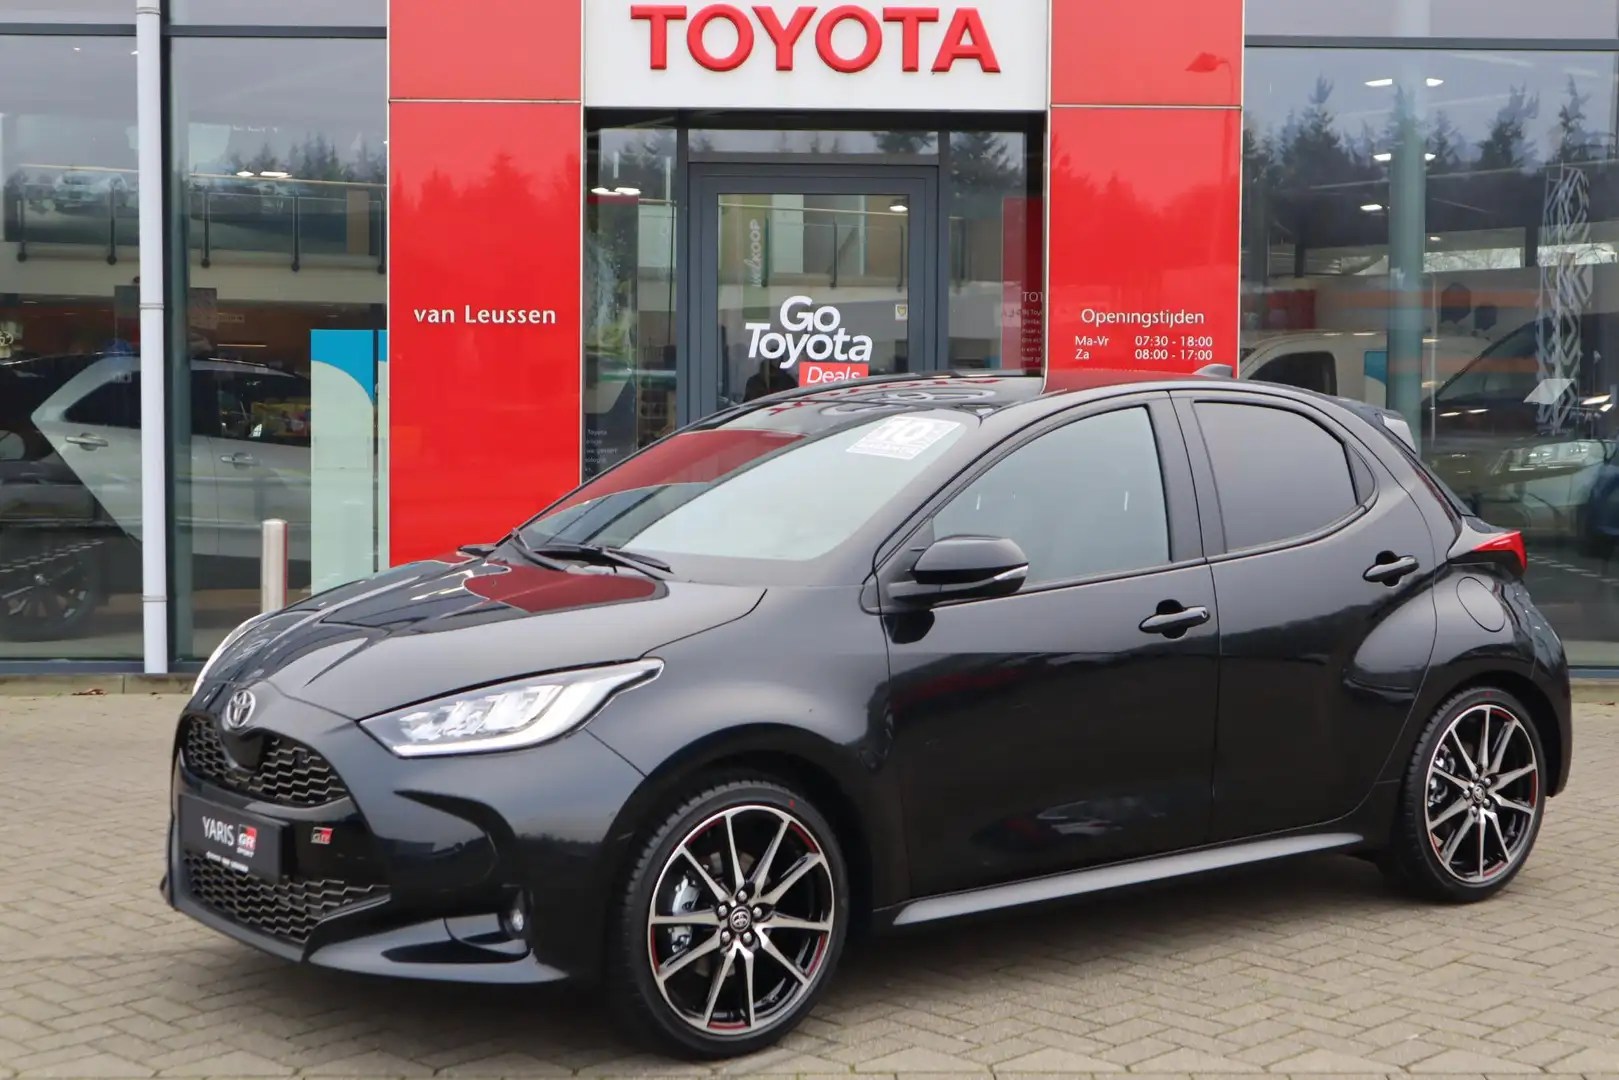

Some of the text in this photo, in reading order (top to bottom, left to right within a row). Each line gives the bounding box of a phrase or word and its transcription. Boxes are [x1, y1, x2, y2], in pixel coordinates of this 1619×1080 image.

[630, 3, 1001, 74] TOYOTA
[413, 304, 557, 324] van Leussen
[779, 295, 841, 332] Go
[1081, 308, 1205, 328] Openingstijden
[745, 322, 873, 369] Toyota
[1075, 335, 1110, 346] Ma-Vr
[1135, 335, 1168, 347] 07:30
[1180, 336, 1213, 347] 18:00
[1075, 348, 1090, 360] Za
[1135, 348, 1168, 360] 08:00
[1180, 349, 1213, 360] 17:00
[202, 815, 235, 847] YARIS
